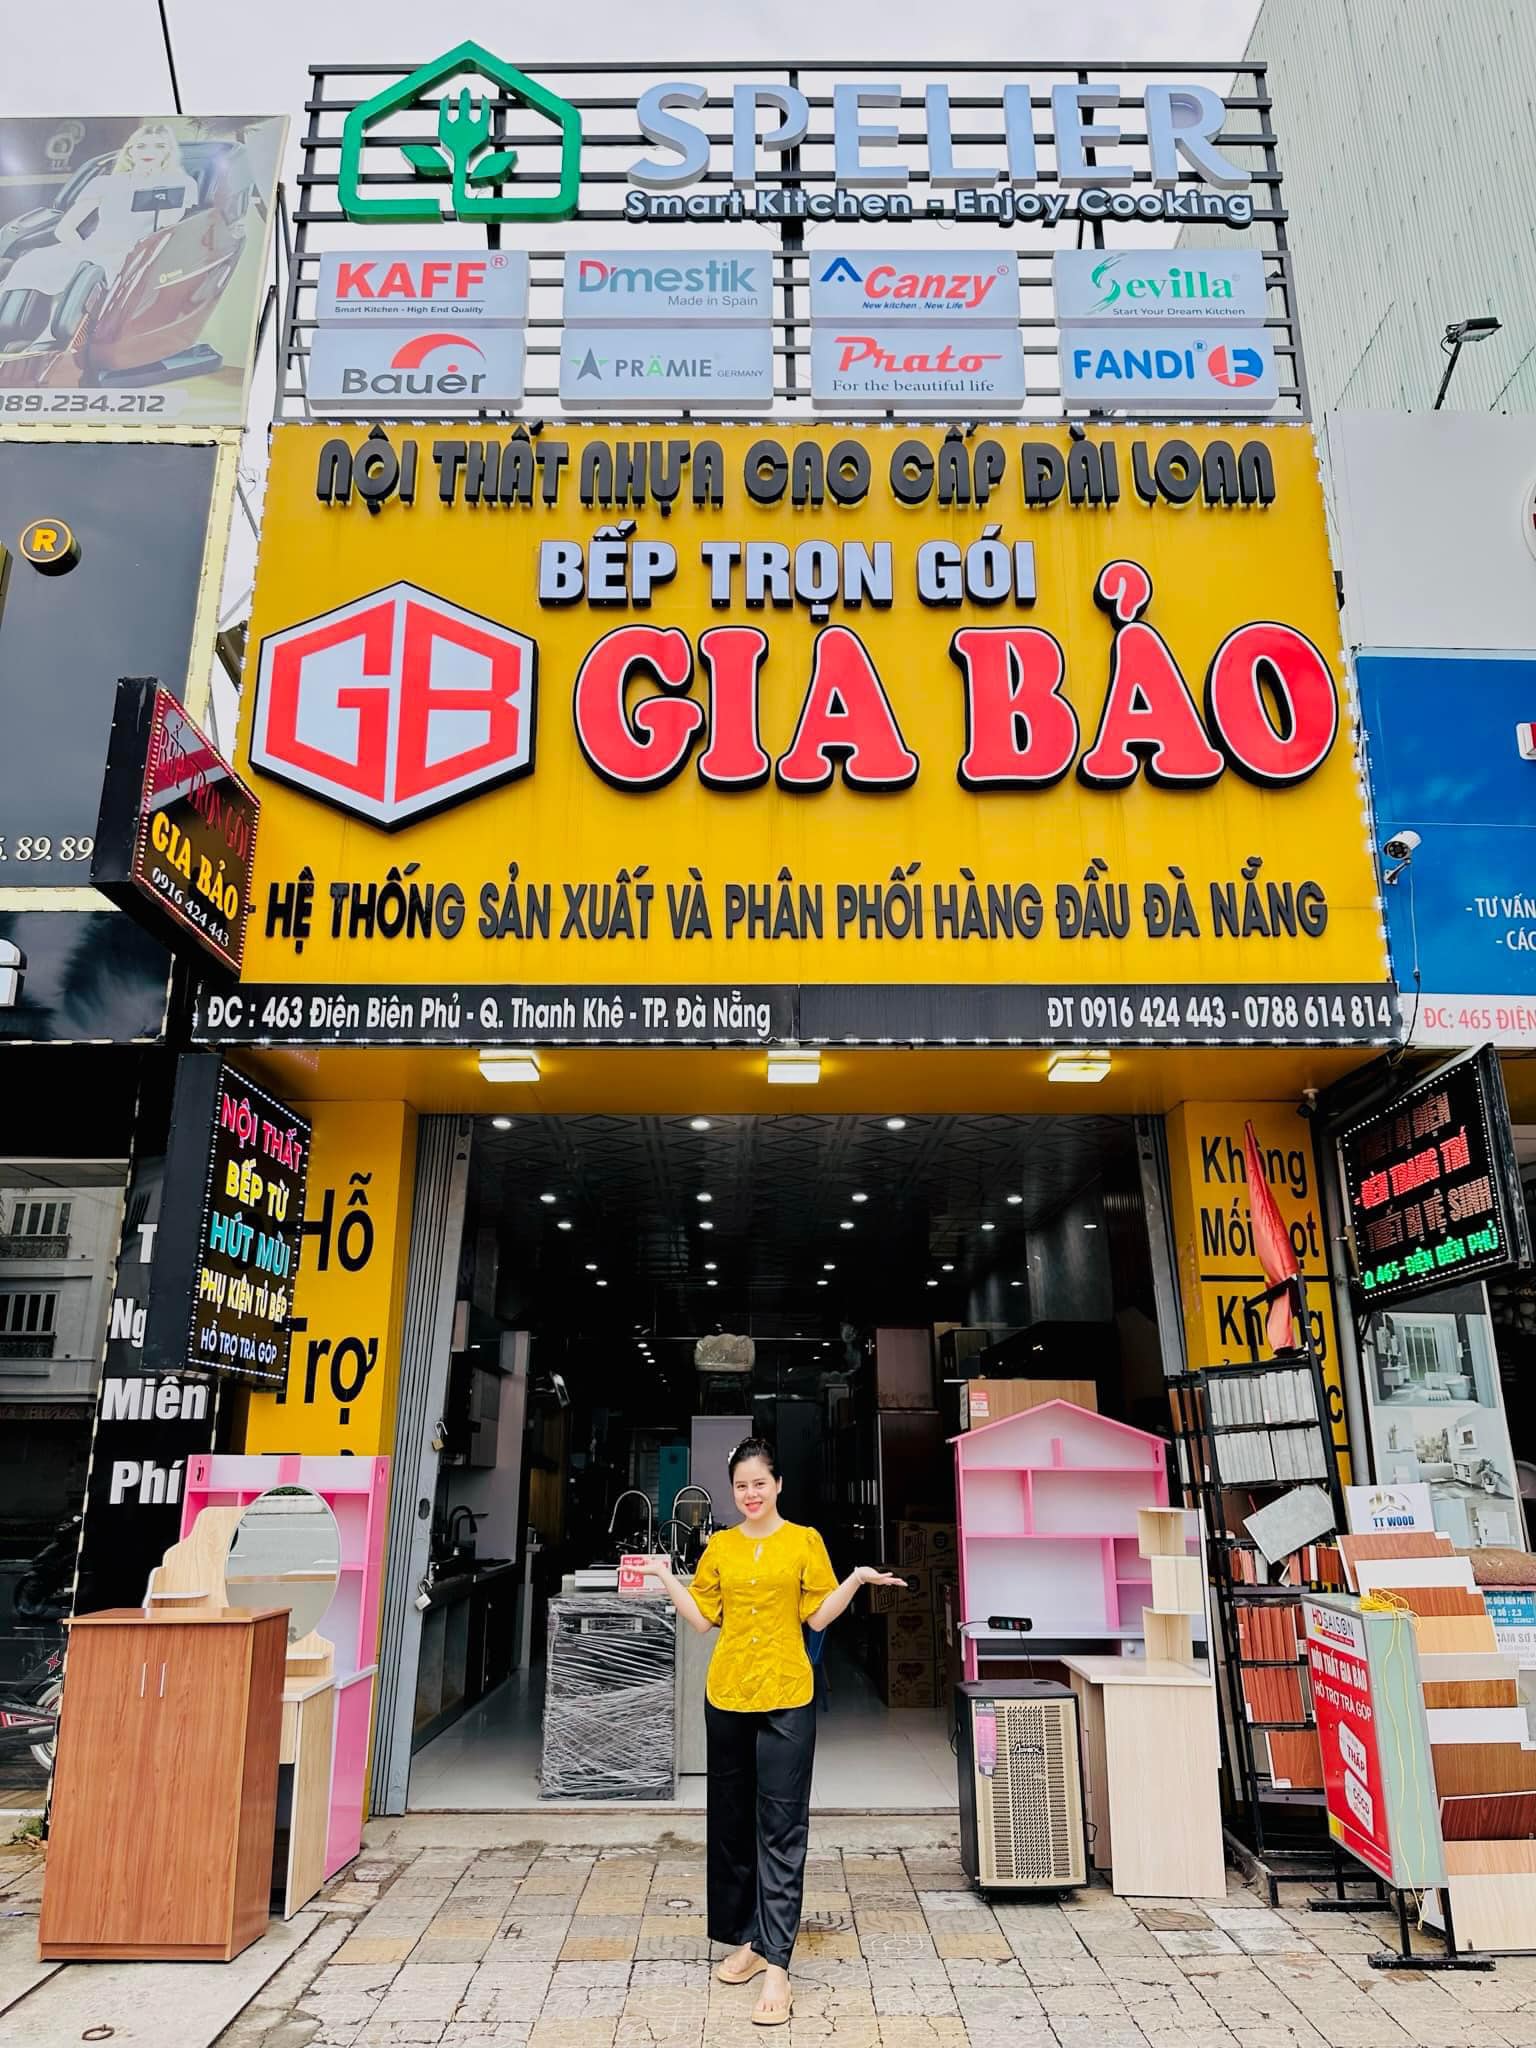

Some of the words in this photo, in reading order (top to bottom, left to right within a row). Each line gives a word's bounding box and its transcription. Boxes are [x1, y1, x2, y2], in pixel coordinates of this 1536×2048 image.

[627, 82, 1253, 189] SPELIER
[626, 191, 745, 219] Smart
[757, 189, 913, 219] Kitchen
[956, 189, 1068, 225] Enjoy
[1079, 189, 1253, 226] Cooking
[336, 262, 488, 298] KAFF
[668, 295, 703, 306] Made
[707, 295, 718, 306] in
[722, 295, 758, 308] Spain
[864, 265, 997, 309] Canzy
[1089, 256, 1234, 312] Sevilla
[407, 306, 429, 315] High
[451, 306, 484, 314] Quality
[862, 301, 883, 309] New
[884, 301, 917, 310] kitchen
[924, 301, 945, 310] New
[946, 301, 963, 310] Life
[1113, 307, 1138, 316] Start
[1141, 307, 1164, 316] Your
[1167, 307, 1202, 316] Dream
[1205, 307, 1246, 316] Kitchen
[614, 354, 712, 378] PRÄMIE
[716, 369, 764, 377] GERMANY
[834, 335, 1004, 373] Prato
[1073, 349, 1195, 380] FANDI
[342, 366, 487, 394] Bauer
[833, 380, 860, 392] For
[864, 380, 889, 392] the
[895, 379, 965, 392] beautiful
[969, 379, 995, 392] life
[0, 394, 166, 413] 89.234.212
[316, 425, 418, 514] NỘI
[432, 420, 569, 504] THẤT
[743, 439, 872, 506] CAO
[889, 422, 1006, 506] CẤP
[1020, 424, 1121, 507] ĐÀI
[1131, 439, 1277, 508] LOAN
[538, 520, 678, 608] BẾP
[701, 539, 894, 624] TRỌN
[916, 524, 1038, 608] GÓI
[573, 624, 919, 794] GIA
[949, 559, 1339, 793] BẢO
[265, 598, 522, 805] GB
[152, 811, 192, 880] GIA
[196, 854, 239, 921] BẢO
[152, 866, 185, 905] 0916
[184, 900, 208, 927] 424
[208, 922, 230, 947] 443
[265, 866, 315, 954] HỆ
[330, 862, 466, 939] THỐNG
[478, 861, 551, 939] SẢN
[560, 865, 654, 939] XUẤT
[666, 867, 713, 939] VÀ
[725, 866, 824, 939] PHÂN
[837, 862, 923, 939] PHỐI
[935, 867, 1044, 939] HÀNG
[1056, 858, 1130, 939] ĐẦU
[1144, 865, 1200, 938] ĐÀ
[1210, 856, 1329, 938] NẴNG
[207, 995, 243, 1028] ĐC
[262, 996, 303, 1028] 463
[309, 995, 359, 1037] Điện
[366, 995, 414, 1028] Biên
[420, 992, 461, 1028] Phủ
[479, 997, 504, 1029] Q.
[511, 997, 576, 1028] Thanh
[583, 995, 624, 1028] Khê
[641, 997, 669, 1028] TP.
[676, 994, 707, 1028] Đà
[713, 991, 771, 1037] Nẵng
[1047, 997, 1075, 1028] ĐT
[1081, 996, 1134, 1028] 0916
[1139, 996, 1180, 1028] 424
[1186, 996, 1227, 1028] 443
[1244, 996, 1299, 1028] 0788
[1304, 996, 1346, 1028] 614
[1351, 995, 1393, 1027] 814
[1458, 1009, 1492, 1030] 465
[221, 1092, 259, 1149] NỘI
[262, 1127, 303, 1174] THẤT
[225, 1157, 264, 1208] BẾP
[1201, 1135, 1308, 1199] Khng
[209, 1210, 255, 1263] HÚT
[254, 1230, 291, 1280] MÙI
[199, 1266, 228, 1314] PHỤ
[226, 1273, 255, 1320] KIỆN
[254, 1279, 269, 1319] TỦ
[267, 1284, 288, 1324] BẾP
[239, 1332, 256, 1361] TRẢ
[257, 1338, 278, 1365] GÓP
[109, 1459, 186, 1505] Phí
[1373, 1517, 1385, 1528] TT
[1386, 1515, 1415, 1527] WOOD
